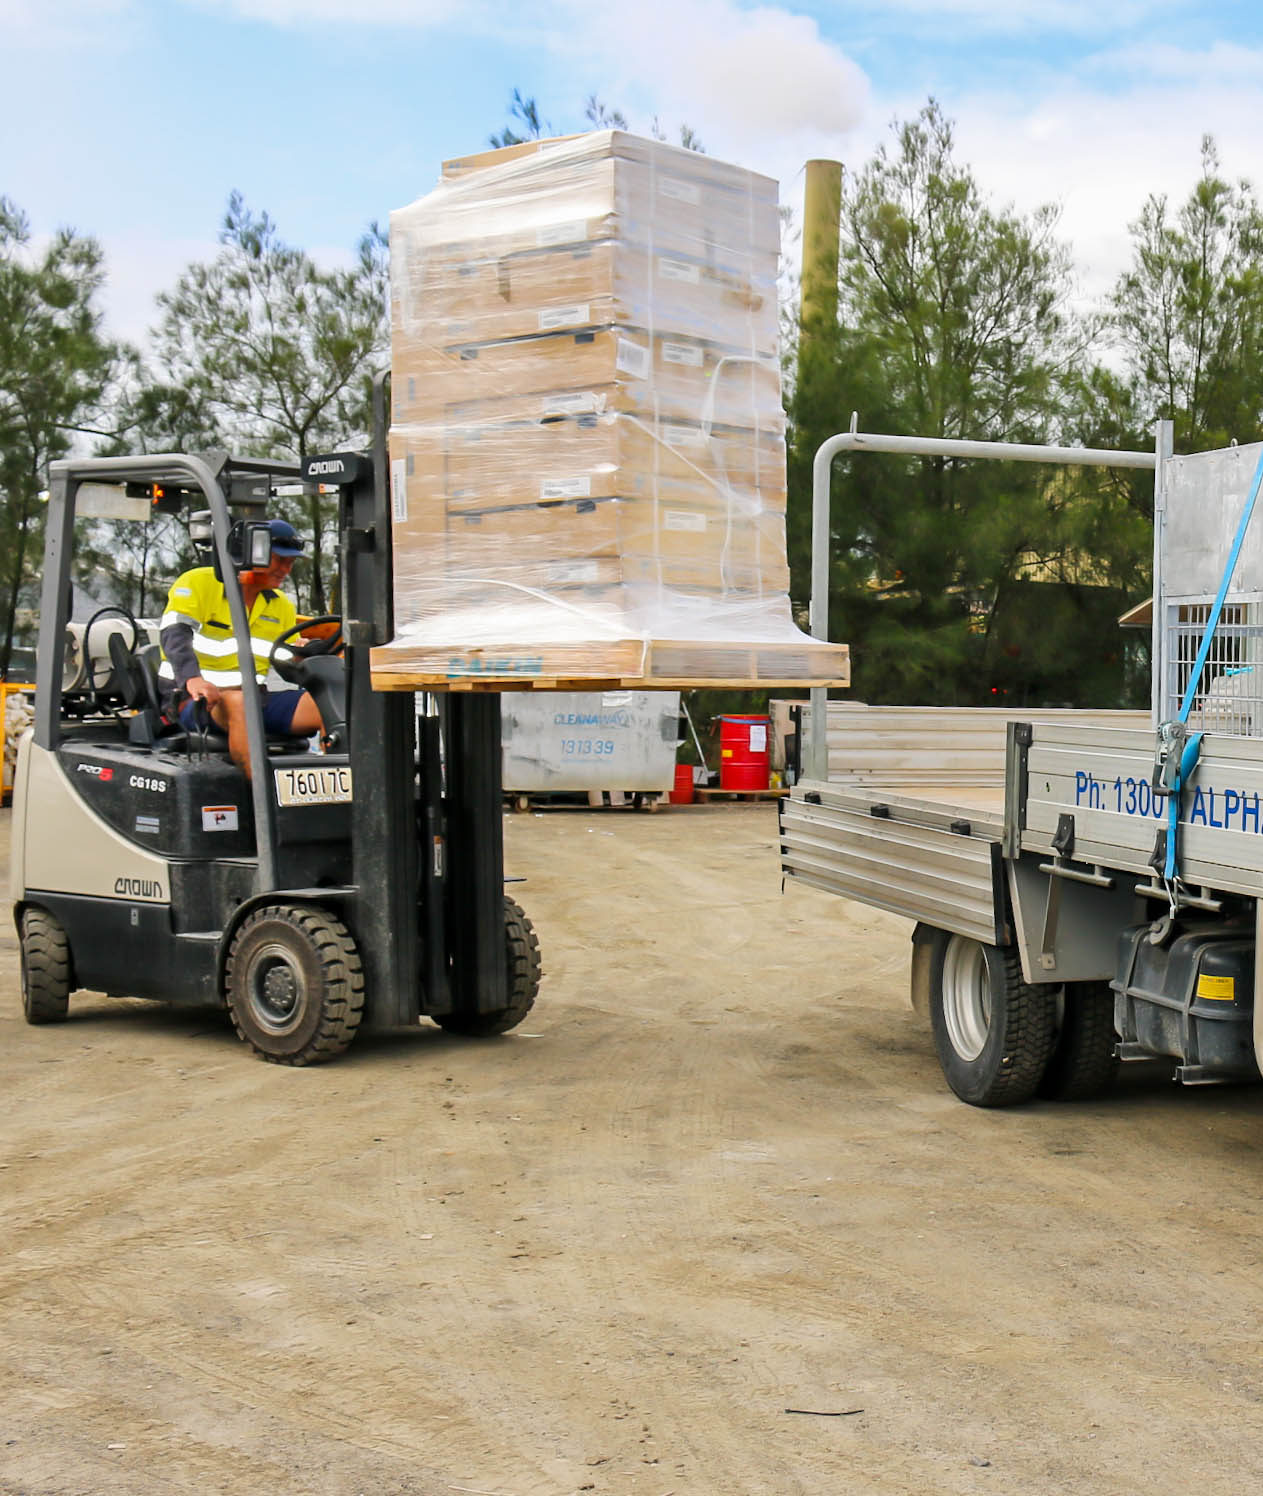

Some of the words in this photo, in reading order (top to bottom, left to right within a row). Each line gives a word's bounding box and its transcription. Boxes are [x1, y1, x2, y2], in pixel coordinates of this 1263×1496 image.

[308, 460, 344, 475] CROWN
[129, 775, 167, 793] CG18S
[1075, 771, 1106, 811] Ph:
[114, 877, 163, 898] CROWN
